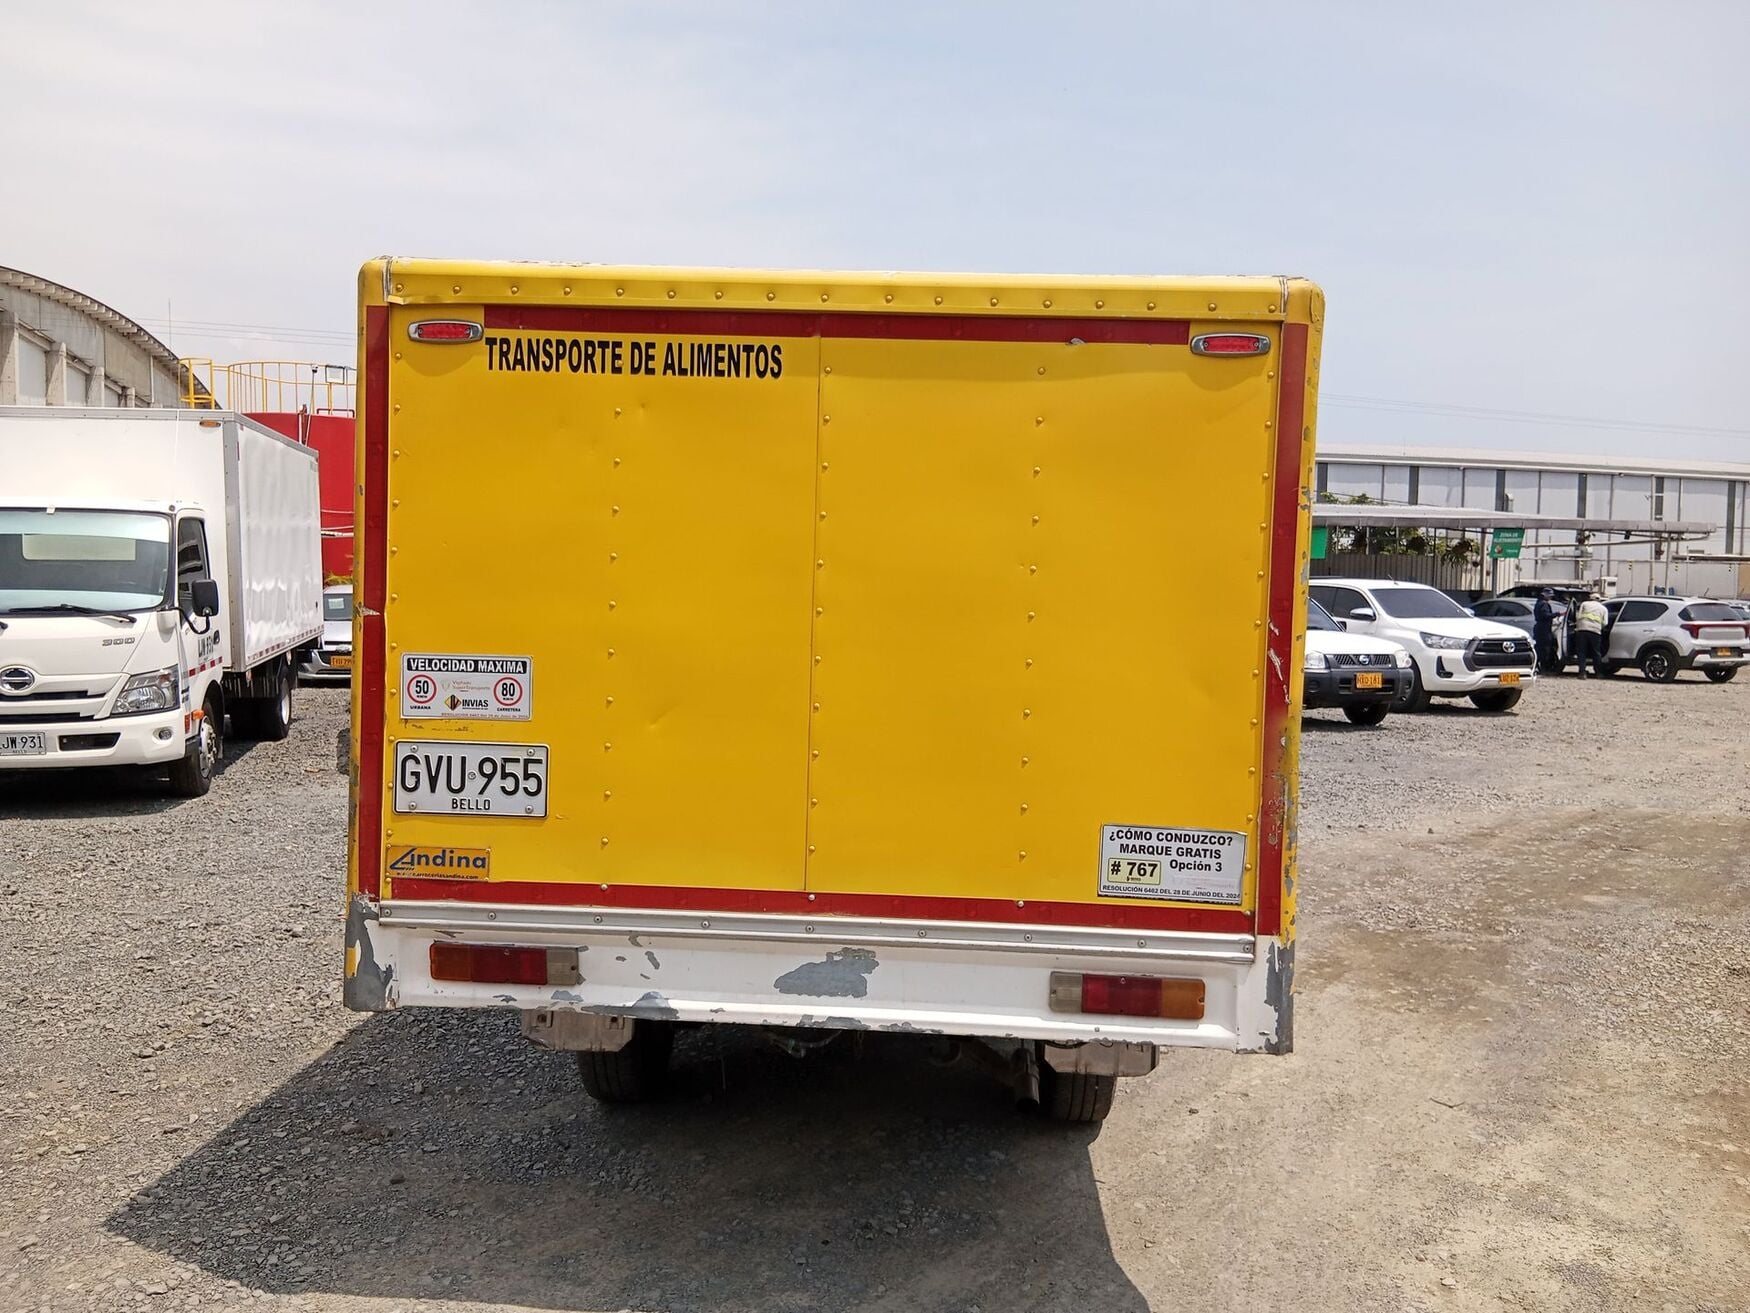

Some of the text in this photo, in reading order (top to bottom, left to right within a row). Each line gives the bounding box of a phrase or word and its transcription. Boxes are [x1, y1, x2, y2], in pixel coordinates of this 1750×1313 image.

[485, 337, 783, 379] TRANSPORTE DE ALIMENTOS
[102, 637, 135, 647] 300
[410, 658, 524, 673] VELOCIDAD MAXIMA
[415, 680, 430, 695] 50
[501, 682, 516, 697] 80
[462, 699, 489, 708] INVIAS
[20, 735, 43, 749] 931
[451, 798, 491, 811] BELLO
[1109, 828, 1233, 846] ¿CÓMO CONDUZCO?
[389, 847, 486, 870] Andina
[1119, 843, 1222, 859] MARQUE GRATIS
[1110, 860, 1158, 877] # 767
[1169, 859, 1222, 872] Opción 3
[1102, 885, 1143, 893] RESOLUCIÓN
